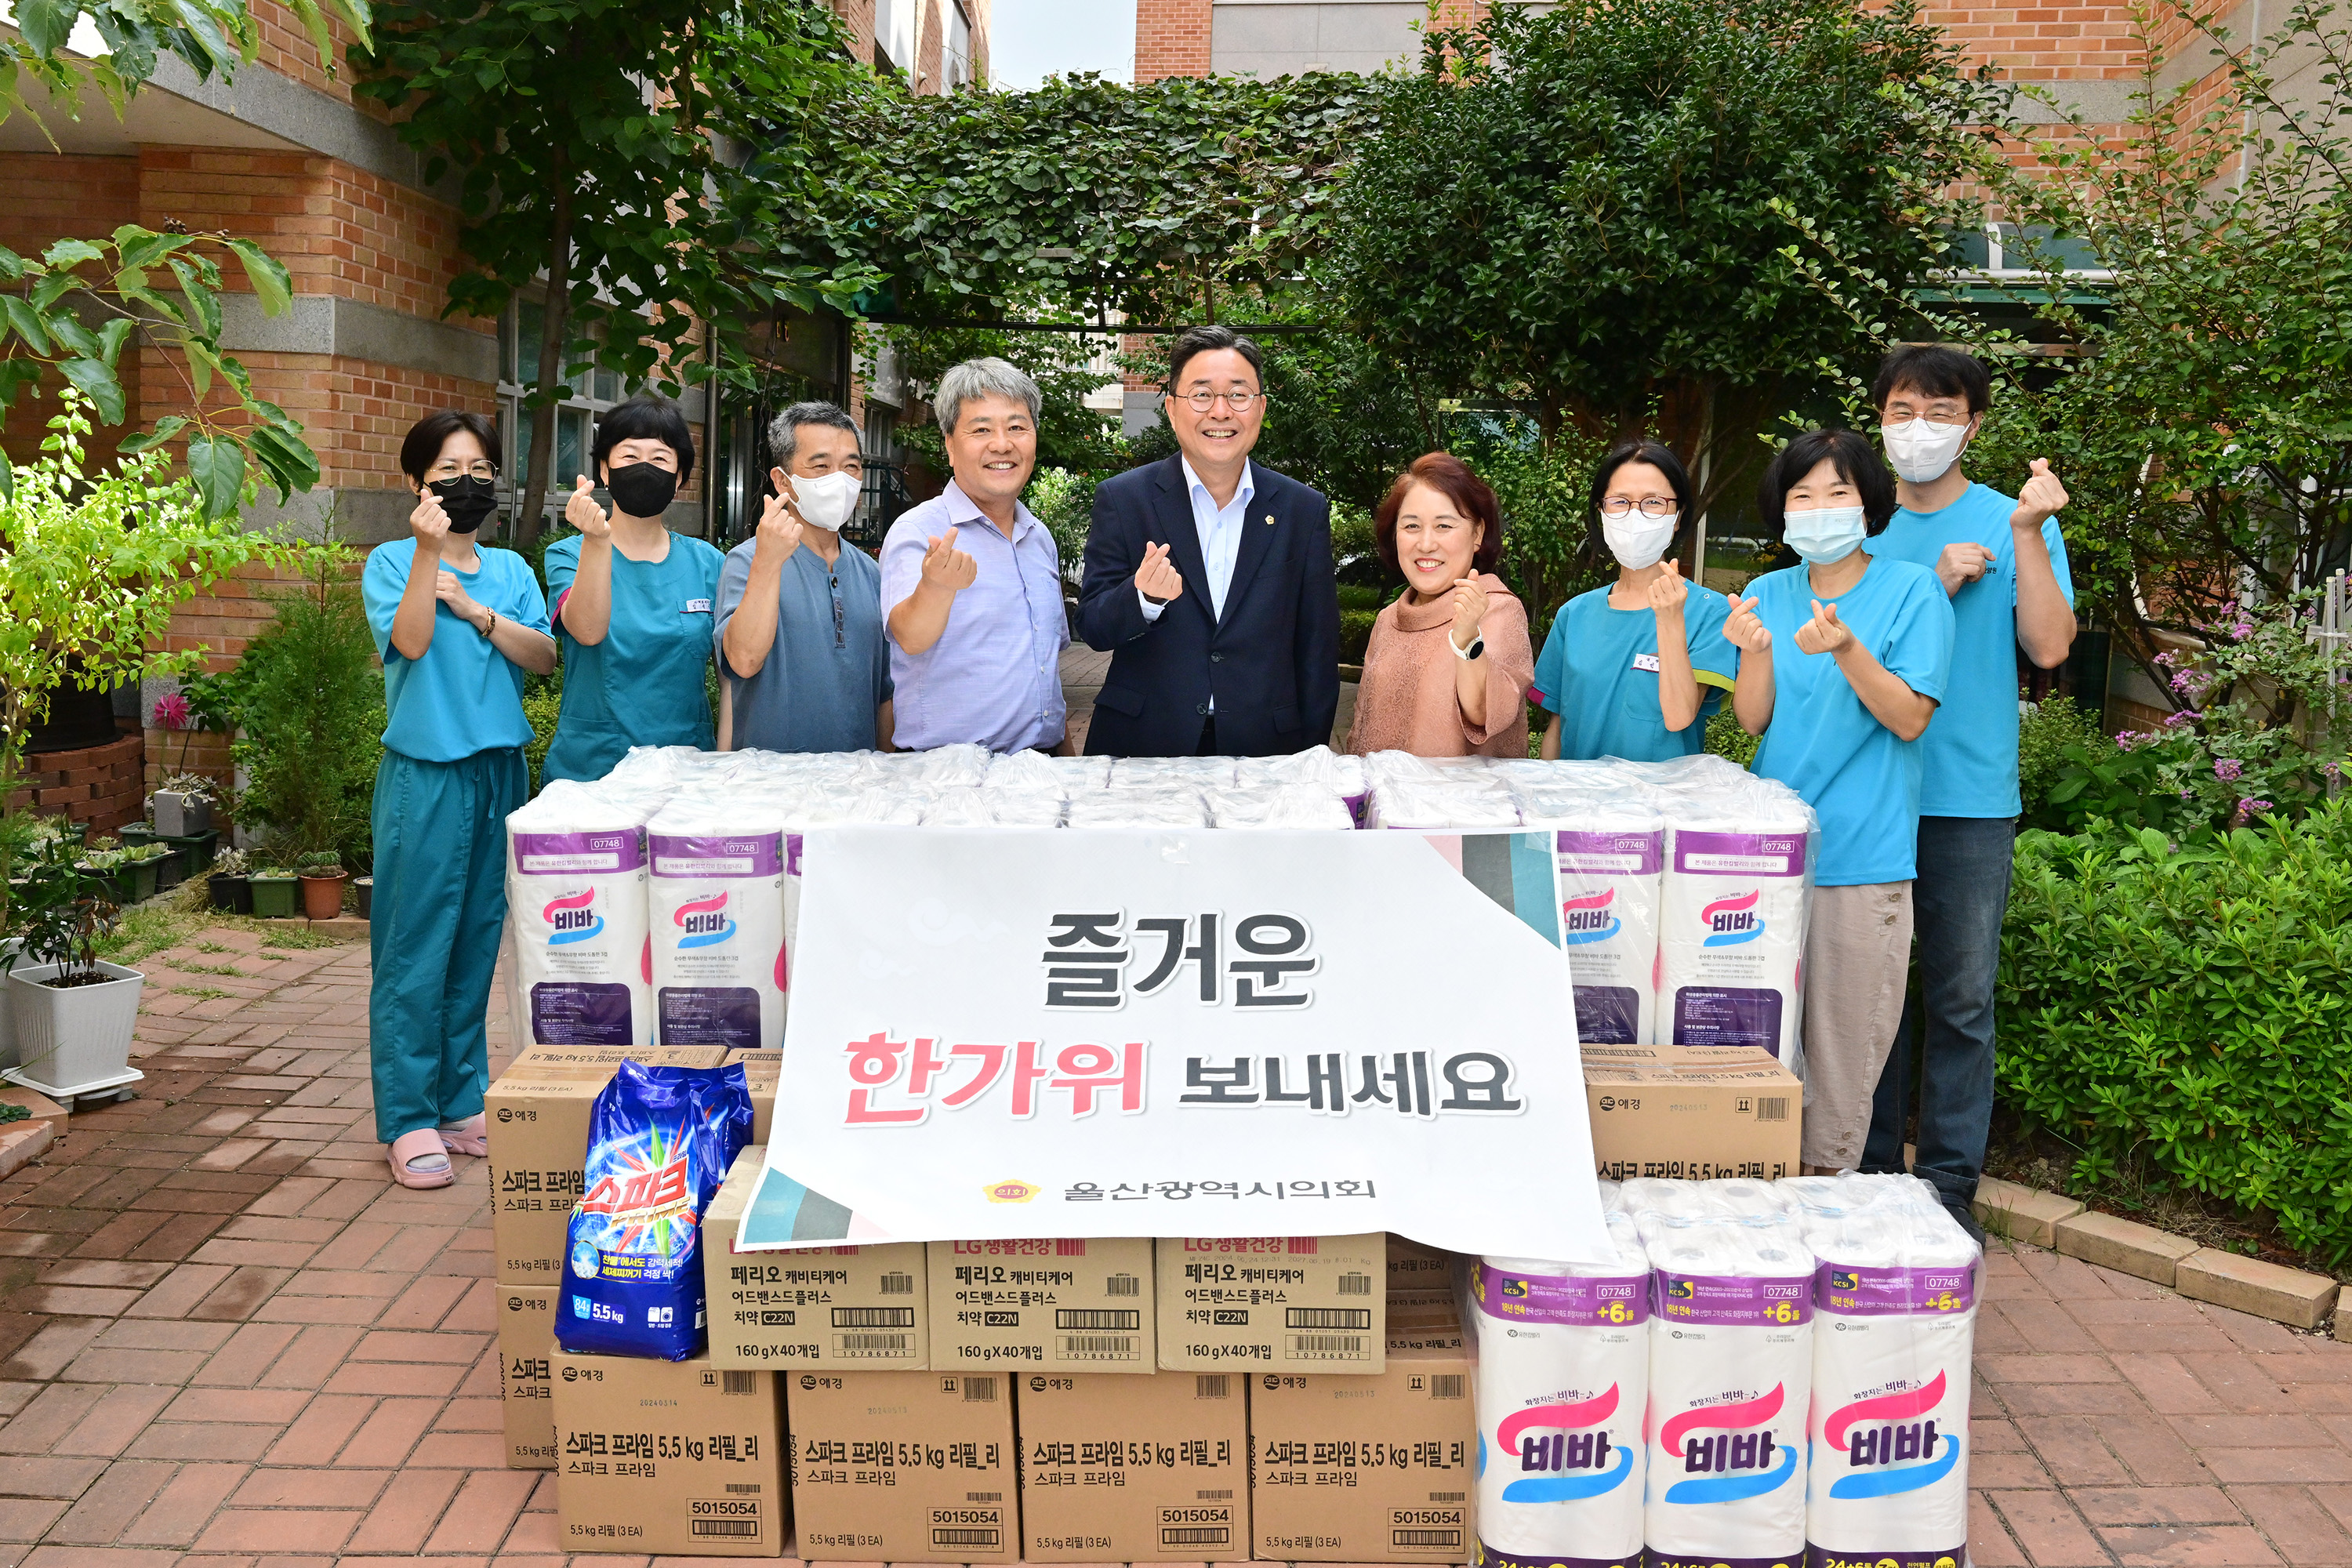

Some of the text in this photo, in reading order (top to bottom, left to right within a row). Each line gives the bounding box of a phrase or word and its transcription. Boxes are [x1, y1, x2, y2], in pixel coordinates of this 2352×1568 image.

[555, 909, 593, 930] 비바
[686, 913, 725, 933] 비바
[1570, 910, 1610, 930] 비바
[1713, 912, 1755, 931] 비바
[1043, 911, 1316, 1007] 즐거운
[844, 1031, 1521, 1123] 한가위 보내세요
[1618, 1099, 1640, 1110] 애경
[515, 1110, 536, 1121] 애경
[1599, 1160, 1684, 1182] 스파크 프라임
[503, 1170, 585, 1194] 스파크 프라임
[583, 1157, 689, 1214] 스파크
[1065, 1180, 1375, 1200] 울산광역시의회
[504, 1199, 543, 1211] 스파크
[612, 1197, 690, 1228] PRIME
[954, 1240, 1051, 1255] LG 생활건강
[1185, 1237, 1283, 1253] LG 생활건강
[508, 1259, 560, 1271] 5.5 kg 리필 (3
[648, 1258, 683, 1267] 강력세척!
[1388, 1260, 1444, 1272] kg 리필 (3 EA)
[602, 1267, 673, 1279] 세제찌꺼기 걱정 싹!
[731, 1266, 847, 1285] 페리오 캐비티케어
[956, 1266, 1073, 1285] 페리오 캐비티케어
[1185, 1264, 1304, 1284] 페리오 캐비티케어
[1929, 1278, 1960, 1287] 07748
[732, 1291, 832, 1305] 어드밴스드플러스
[956, 1291, 1056, 1306] 어드밴스드플러스
[1185, 1289, 1287, 1305] 어드밴스드플러스
[1601, 1287, 1632, 1297] 07748
[1769, 1287, 1798, 1296] 07748
[525, 1299, 546, 1310] 애경
[1502, 1303, 1525, 1315] 18년 연속
[1831, 1296, 1854, 1308] 18년 연속
[593, 1303, 611, 1319] 5.5
[612, 1311, 623, 1323] kg
[1667, 1304, 1678, 1315] 18년
[1679, 1305, 1690, 1316] 연속
[735, 1311, 793, 1325] 치약 C22N
[957, 1312, 1017, 1327] 치약 C22N
[1186, 1310, 1246, 1325] 치약 C22N
[1410, 1341, 1422, 1349] kg
[1426, 1339, 1461, 1348] 리필_리
[512, 1358, 550, 1381] 스파크
[581, 1370, 603, 1381] 애경
[819, 1378, 842, 1389] 애경
[1050, 1379, 1073, 1390] 애경
[1283, 1377, 1306, 1388] 애경
[514, 1386, 551, 1399] 스파크
[1853, 1388, 1882, 1399] 화장지는
[1525, 1396, 1554, 1406] 화장지는
[1690, 1396, 1719, 1407] 화장지는
[566, 1432, 758, 1461] 스파크 프라임 5.5 kg 리필_리
[1850, 1421, 1939, 1466] 비바
[806, 1440, 999, 1469] 스파크 프라임 5.5 kg 리필_리
[1033, 1439, 1230, 1468] 스파크 프라임 5.5 kg 리필_리
[1265, 1441, 1464, 1469] 스파크 프라임 5.5 kg 리필_리
[1522, 1432, 1611, 1472] 비바
[1686, 1431, 1775, 1472] 비바
[568, 1461, 655, 1477] 스파크 프라임
[808, 1470, 895, 1485] 스파크 프라임
[1035, 1472, 1125, 1486] 스파크 프라임
[1265, 1472, 1357, 1486] 스파크 프라임
[692, 1502, 757, 1515] 5015054
[933, 1511, 999, 1523] 5015054
[1162, 1510, 1229, 1522] 5015054
[1394, 1512, 1461, 1523] 5015054
[1266, 1537, 1341, 1548] 5.5 kg 리필 (3 EA)
